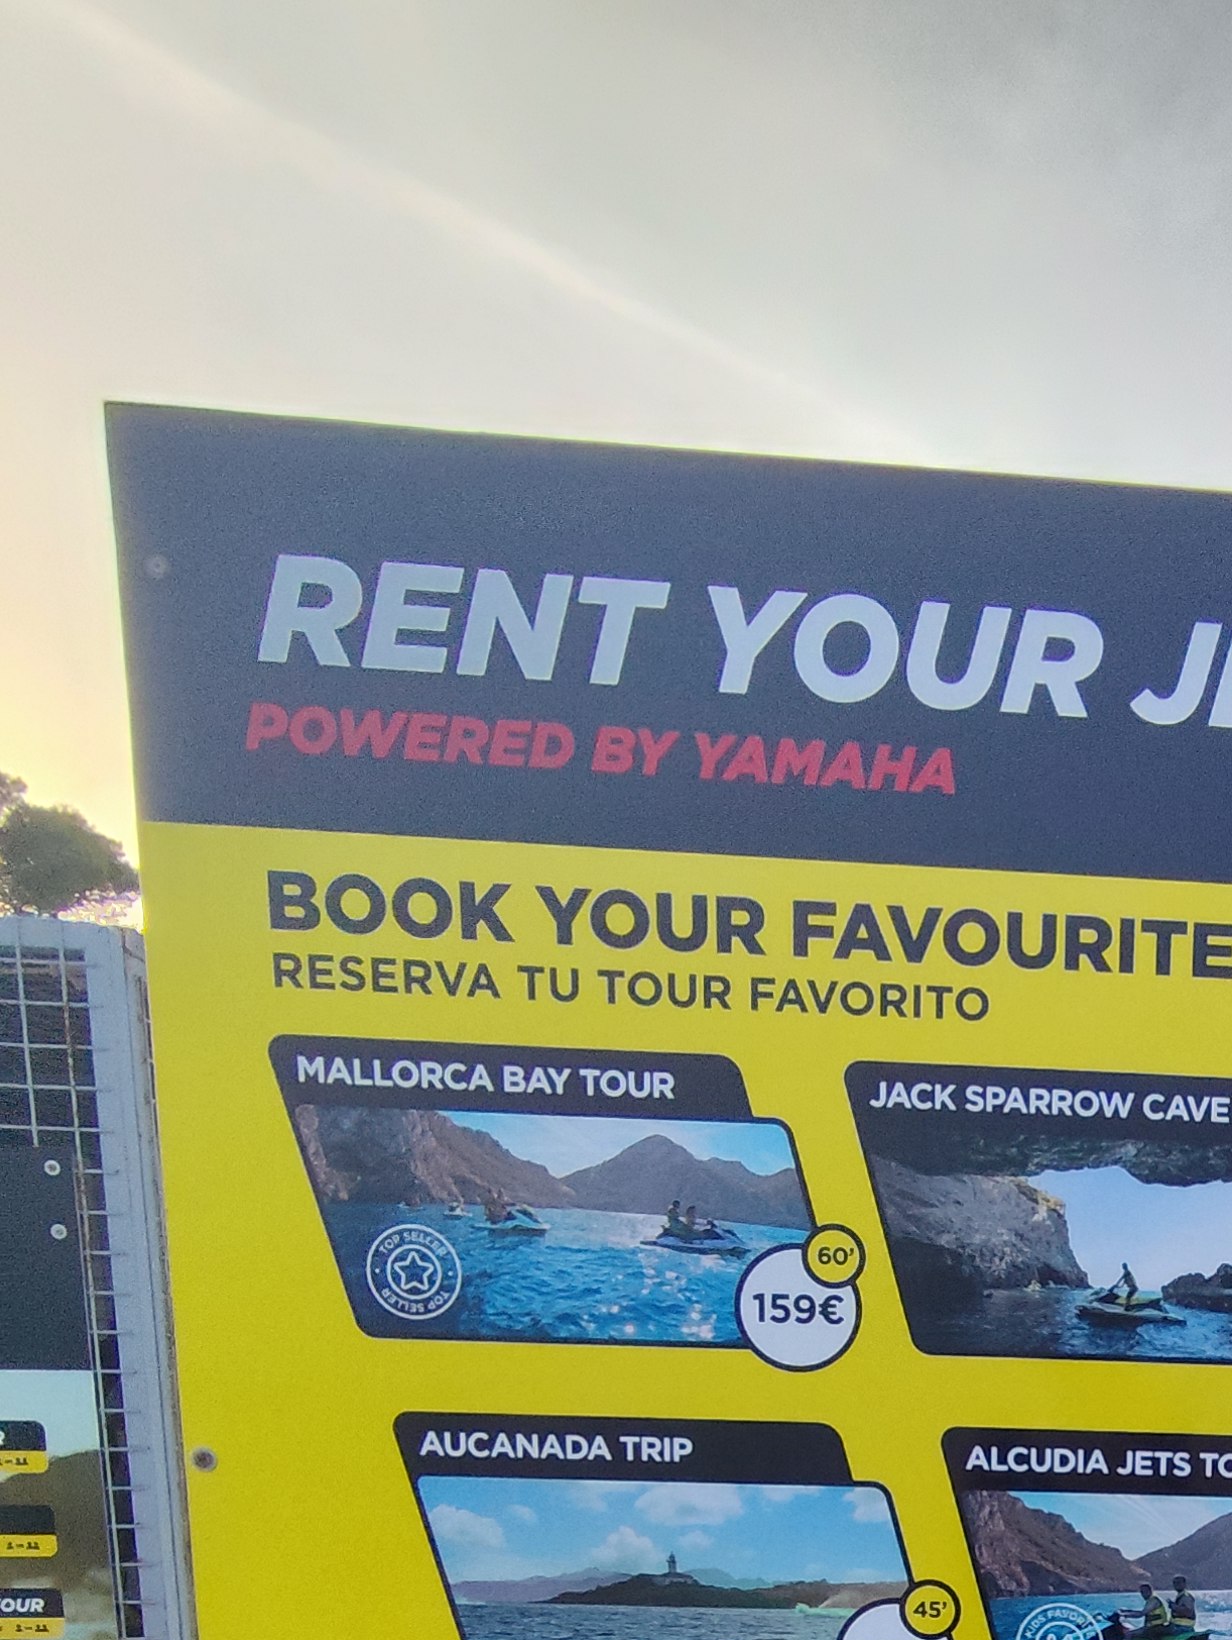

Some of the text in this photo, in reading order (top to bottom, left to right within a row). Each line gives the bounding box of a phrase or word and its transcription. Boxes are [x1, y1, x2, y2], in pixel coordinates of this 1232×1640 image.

[258, 553, 671, 687] RENT
[707, 583, 1105, 719] YOUR
[245, 702, 957, 796] POWERED BY YAMAHA
[267, 869, 514, 943] BOOK
[536, 885, 767, 957] YOUR
[273, 951, 991, 1022] RESERVA TU TOUR FAVORITO
[296, 1055, 676, 1101] MALLORCA BAY TOUR
[868, 1080, 1232, 1126] JACK SPARROW CAVE
[378, 1230, 448, 1257] TOP SELLER
[381, 1288, 450, 1313] TOP SELLER
[751, 1292, 846, 1327] 159€
[418, 1429, 694, 1464] AUCANADA TRIP
[964, 1444, 1110, 1478] ALCUDIA
[1115, 1450, 1193, 1478] JETS
[0, 1598, 45, 1613] OUR
